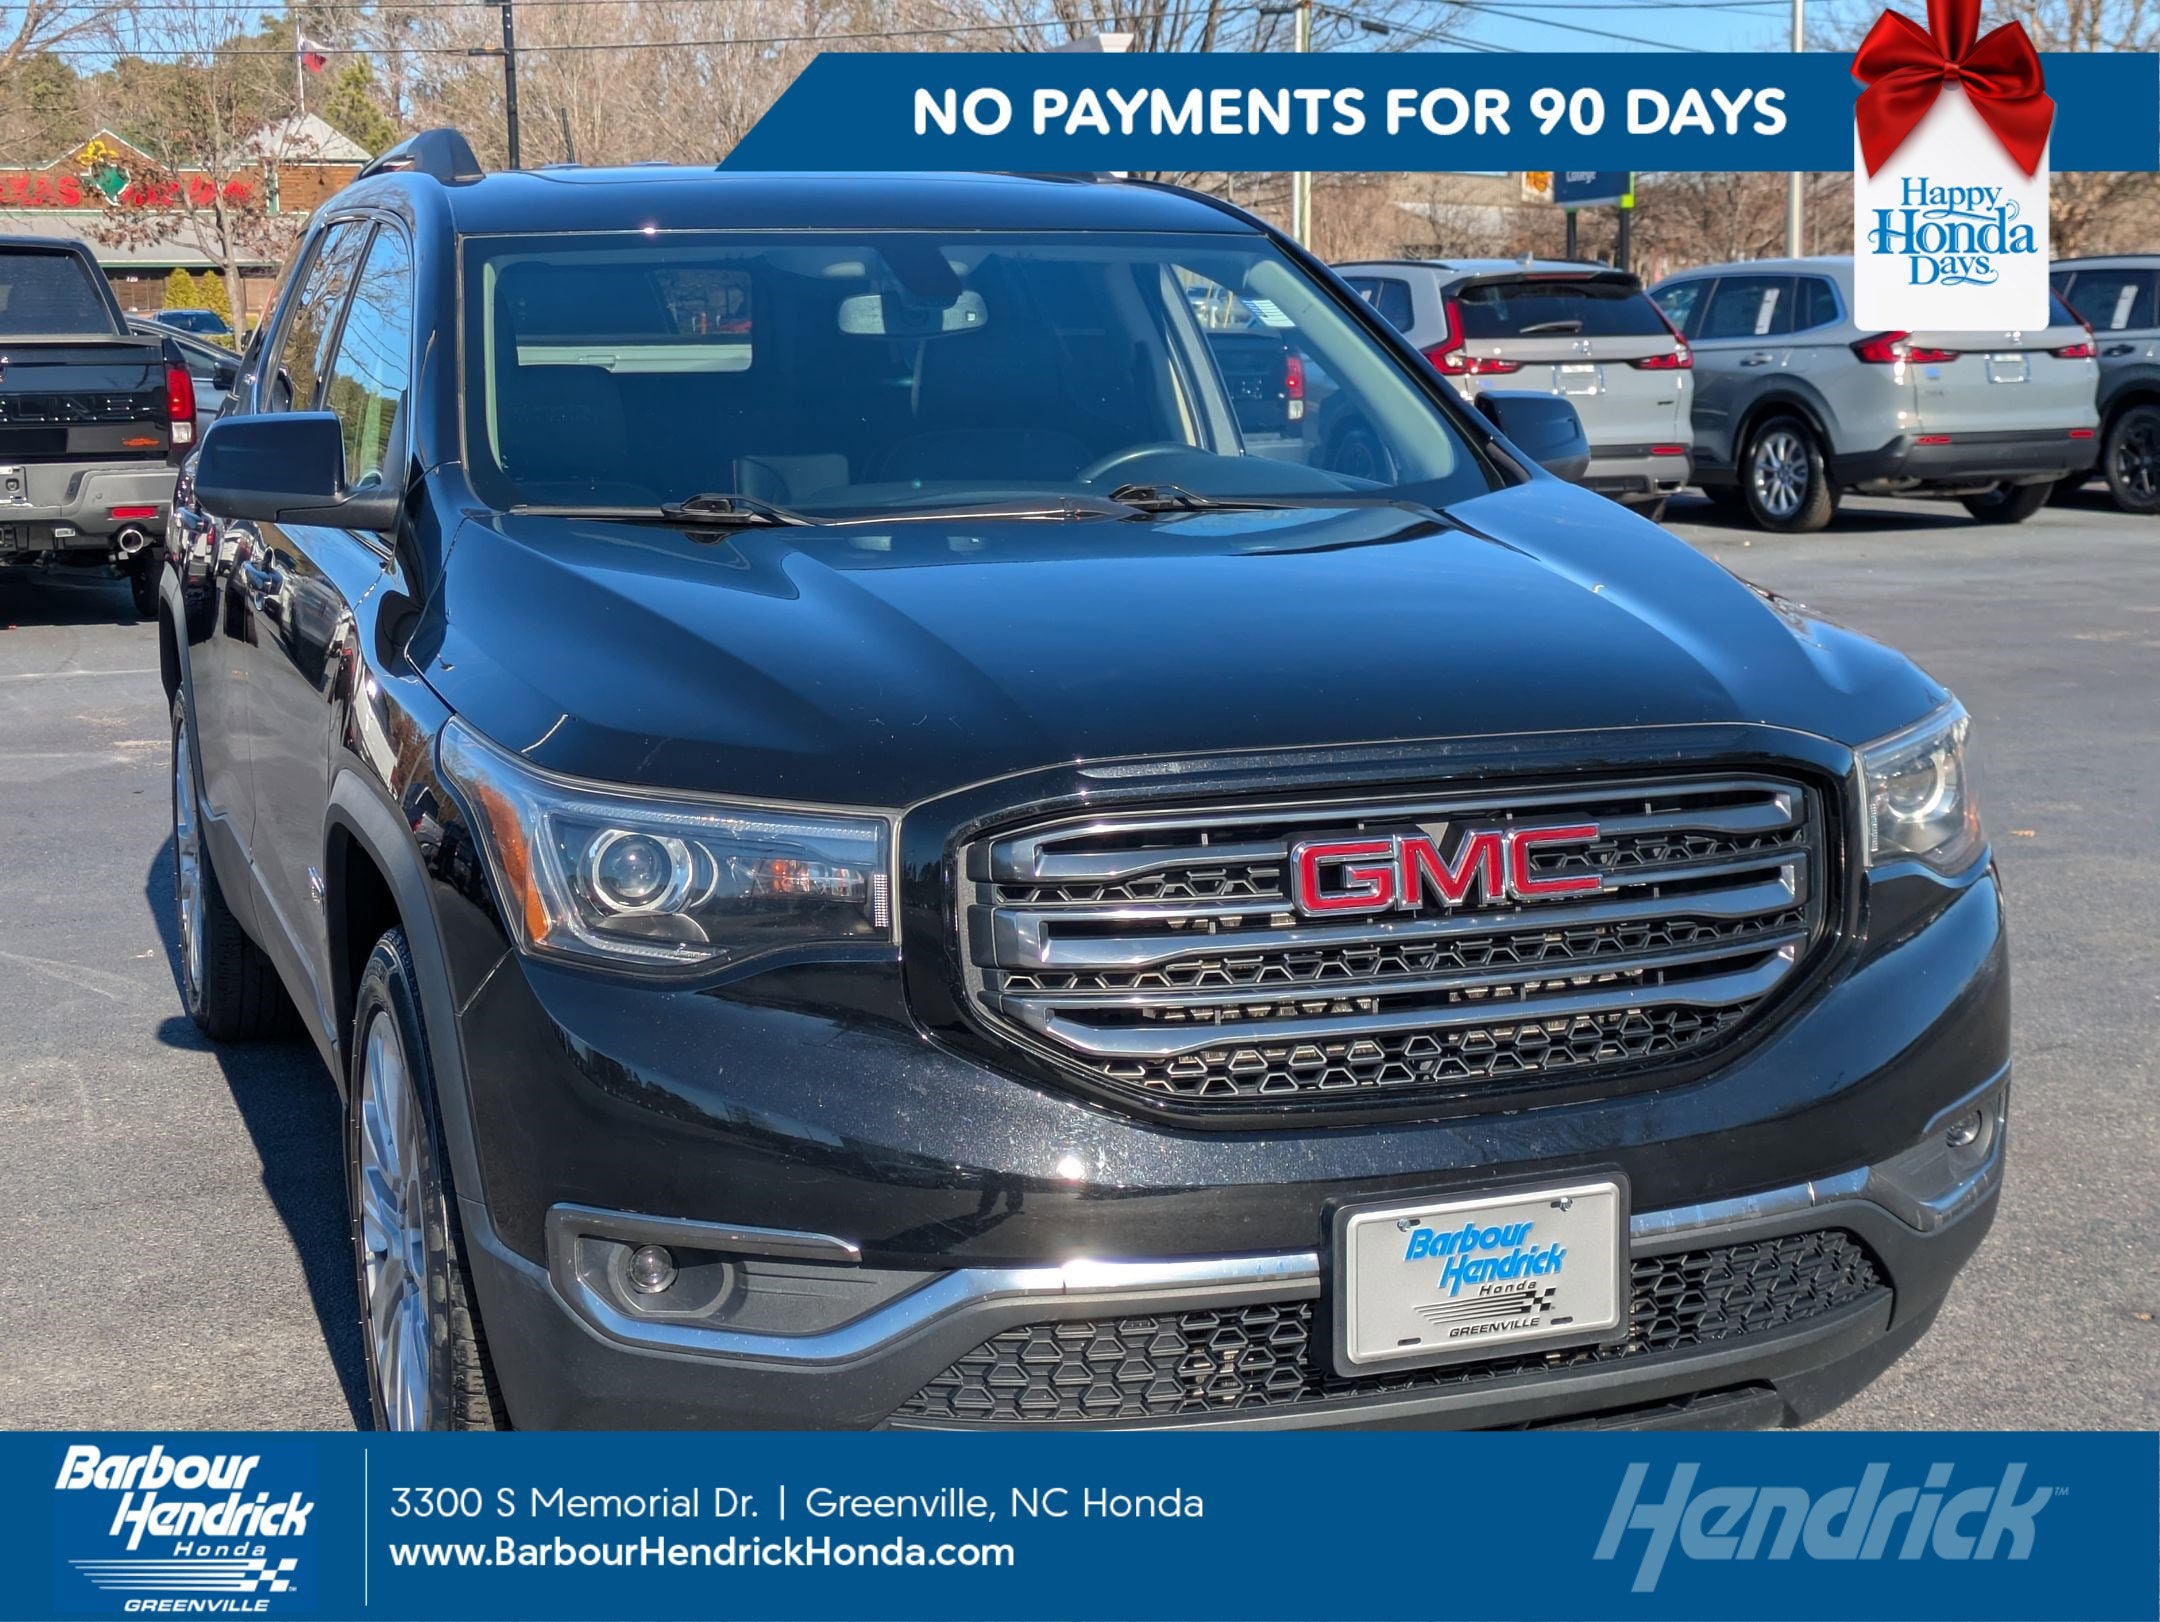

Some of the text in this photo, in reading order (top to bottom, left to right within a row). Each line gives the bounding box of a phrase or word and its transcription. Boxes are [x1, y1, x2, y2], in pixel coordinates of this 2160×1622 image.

[0, 175, 81, 206] XAS
[0, 394, 134, 421] LINE
[1291, 822, 1603, 917] GMC
[1404, 1221, 1534, 1262] Barbour
[1437, 1242, 1567, 1297] Hendrick
[1479, 1280, 1536, 1296] Honda
[1449, 1317, 1540, 1338] GREENVILLE
